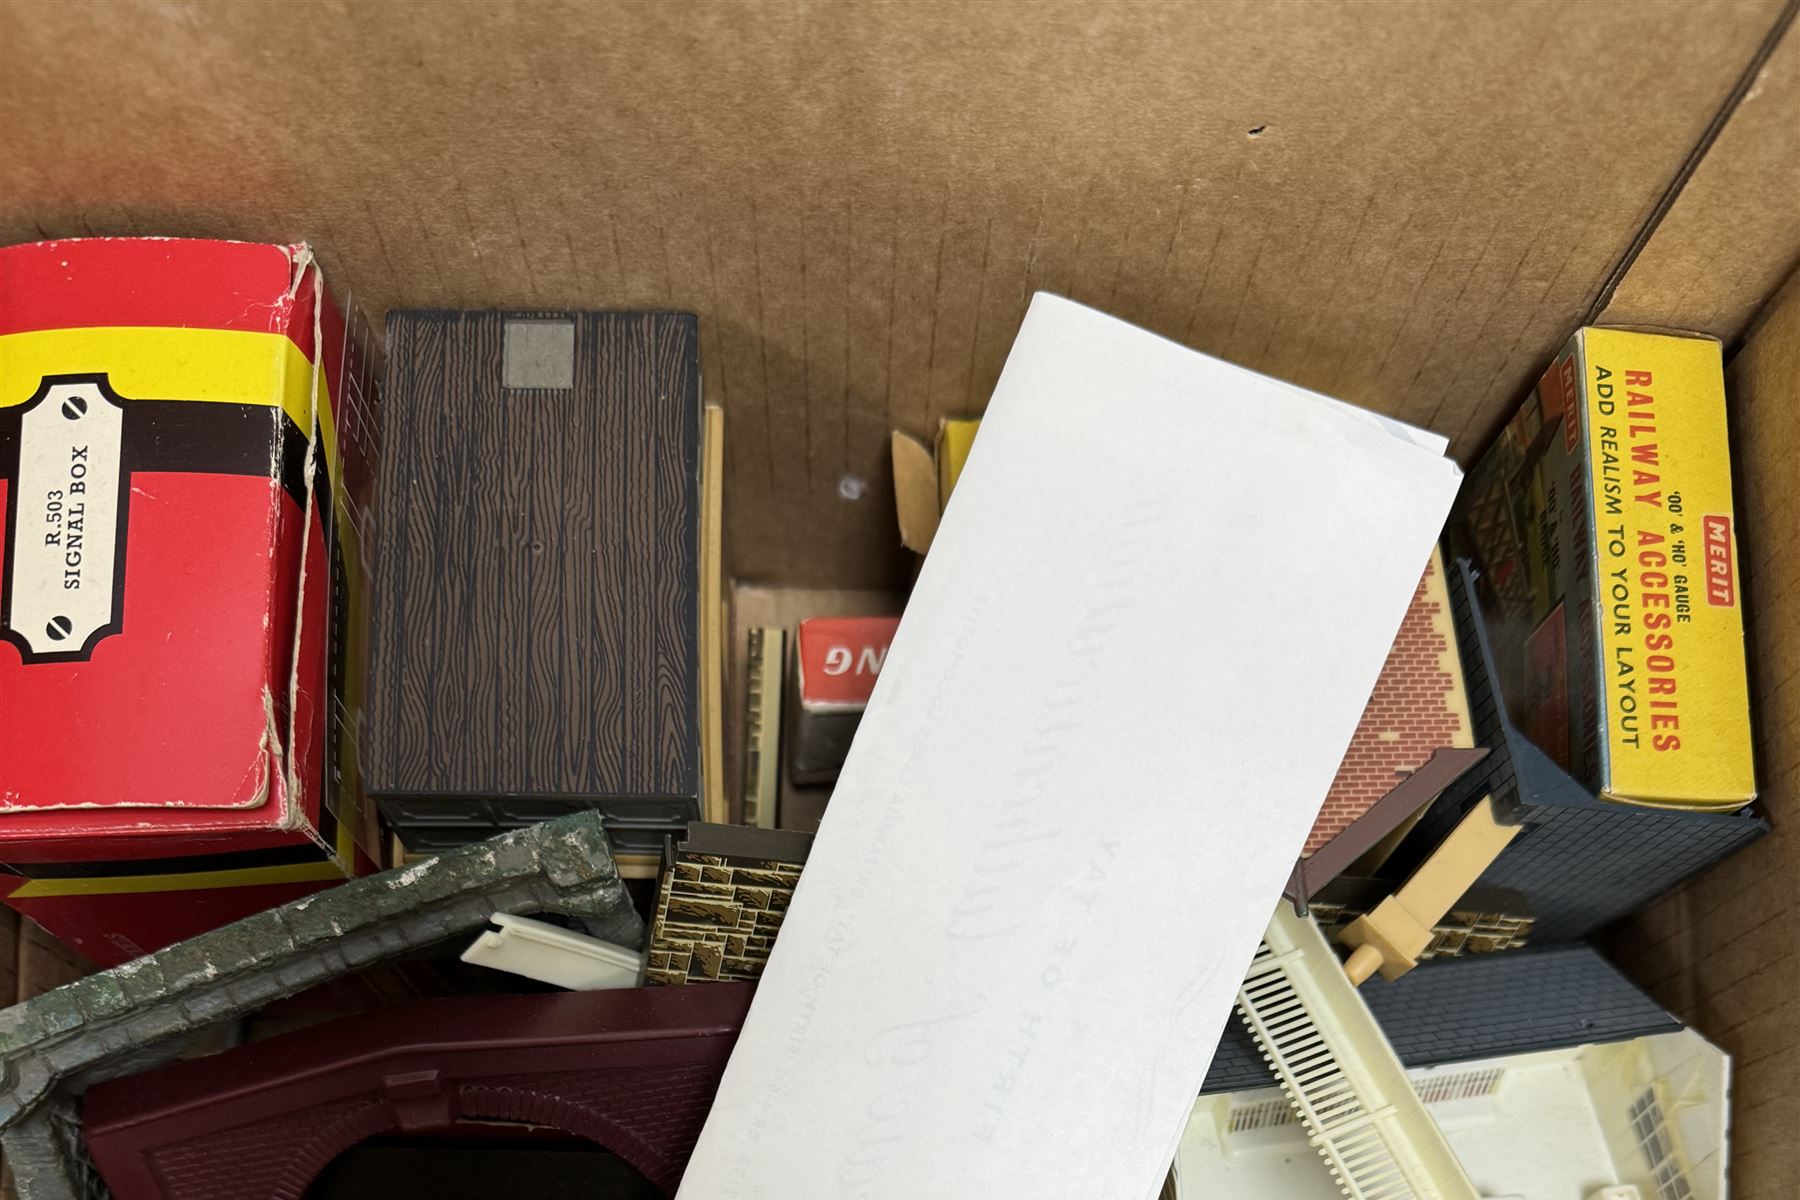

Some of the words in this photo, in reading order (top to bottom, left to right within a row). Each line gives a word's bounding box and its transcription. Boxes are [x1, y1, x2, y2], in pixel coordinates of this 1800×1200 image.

[1563, 365, 1579, 446] MERIT
[1595, 365, 1615, 416] ADD
[70, 445, 88, 495] BOX
[1600, 426, 1623, 515] REALISM
[1625, 370, 1662, 507] RAILWAY
[45, 490, 63, 547] R.503
[64, 503, 85, 589] SIGNAL
[1569, 463, 1590, 583] RAILWAY
[1608, 525, 1625, 558] TO
[1670, 524, 1684, 534] &
[1611, 568, 1632, 636] YOUR
[1674, 575, 1690, 622] GAUGE
[1708, 521, 1729, 602] MERIT
[1637, 530, 1681, 752] ACCESSORIES
[1616, 647, 1639, 750] LAYOUT
